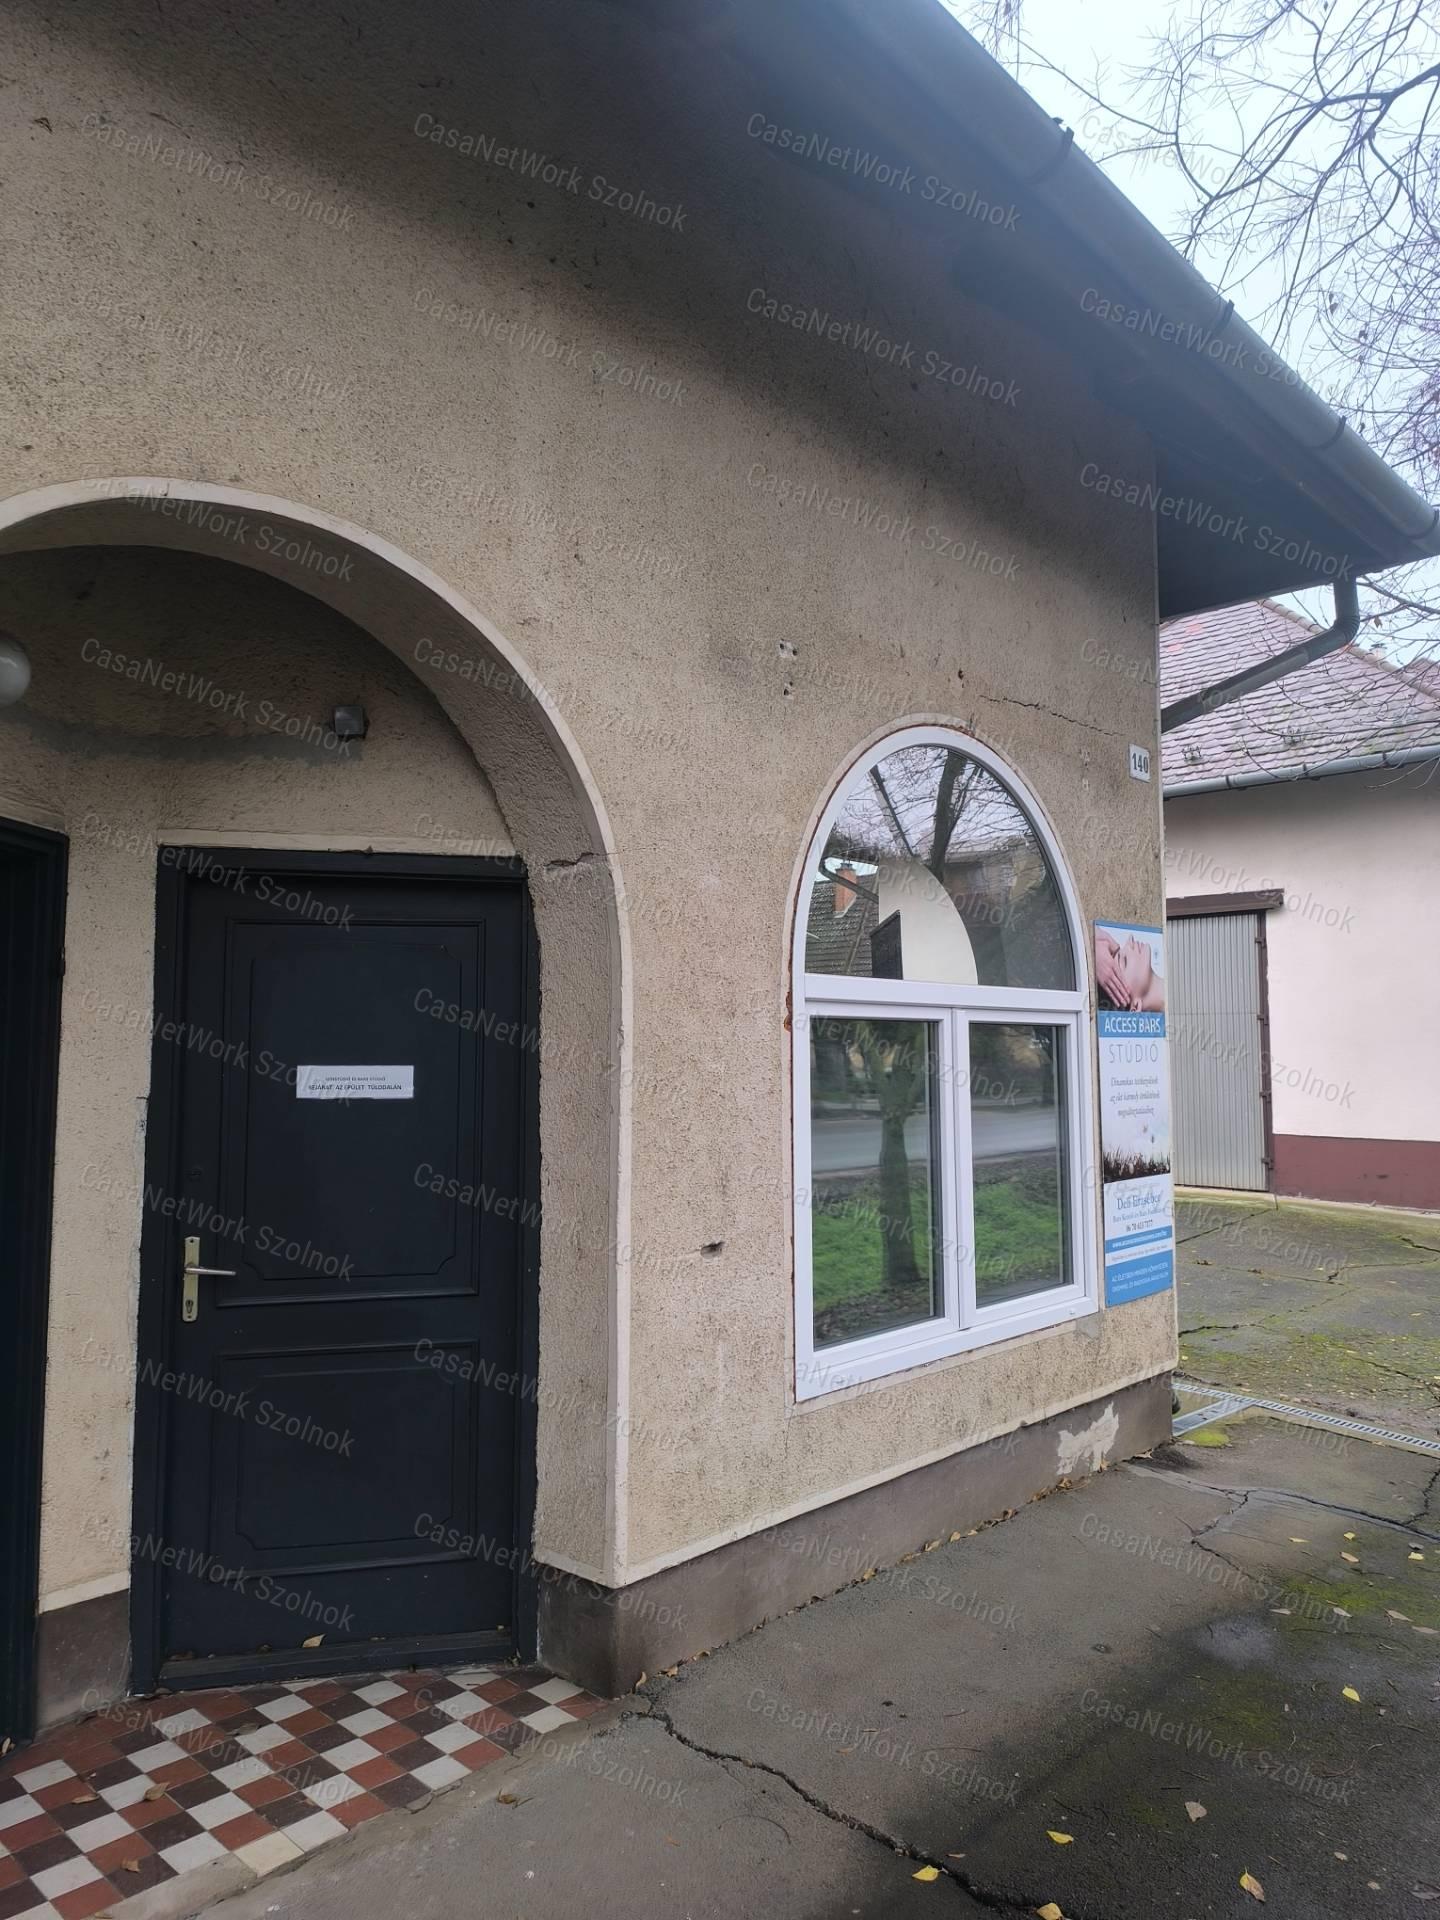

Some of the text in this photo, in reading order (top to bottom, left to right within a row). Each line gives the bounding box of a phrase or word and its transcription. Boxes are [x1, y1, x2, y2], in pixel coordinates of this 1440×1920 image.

[1132, 752, 1149, 774] 140
[1104, 1017, 1161, 1033] ACCESS BARS
[1109, 1040, 1159, 1064] STÚDIÓ
